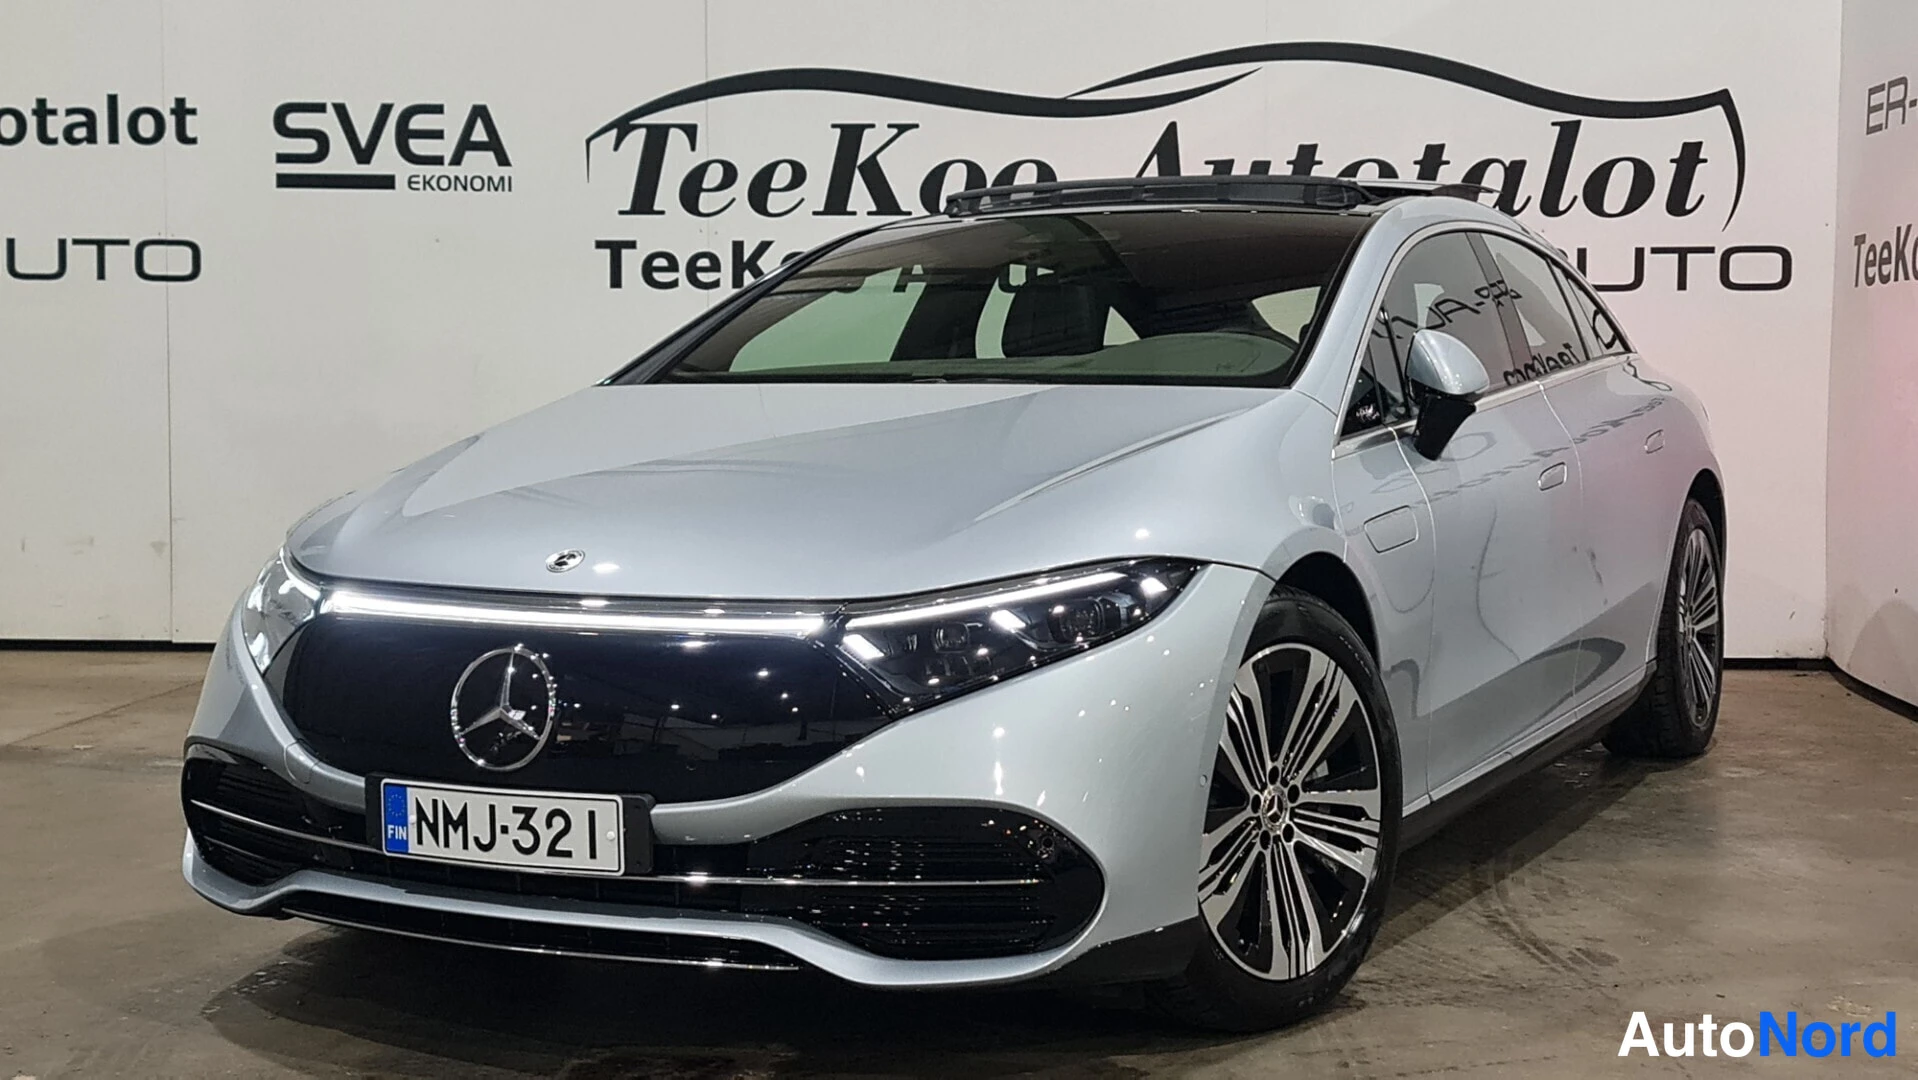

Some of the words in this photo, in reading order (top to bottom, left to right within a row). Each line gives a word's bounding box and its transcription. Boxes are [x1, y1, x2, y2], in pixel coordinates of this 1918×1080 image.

[0, 93, 198, 147] otalot
[272, 102, 512, 167] SVEA
[407, 174, 513, 193] EKONOMI
[594, 239, 804, 290] TeeK
[1560, 245, 1793, 292] UTO
[387, 823, 408, 841] FIN
[415, 796, 597, 860] NMJ-321
